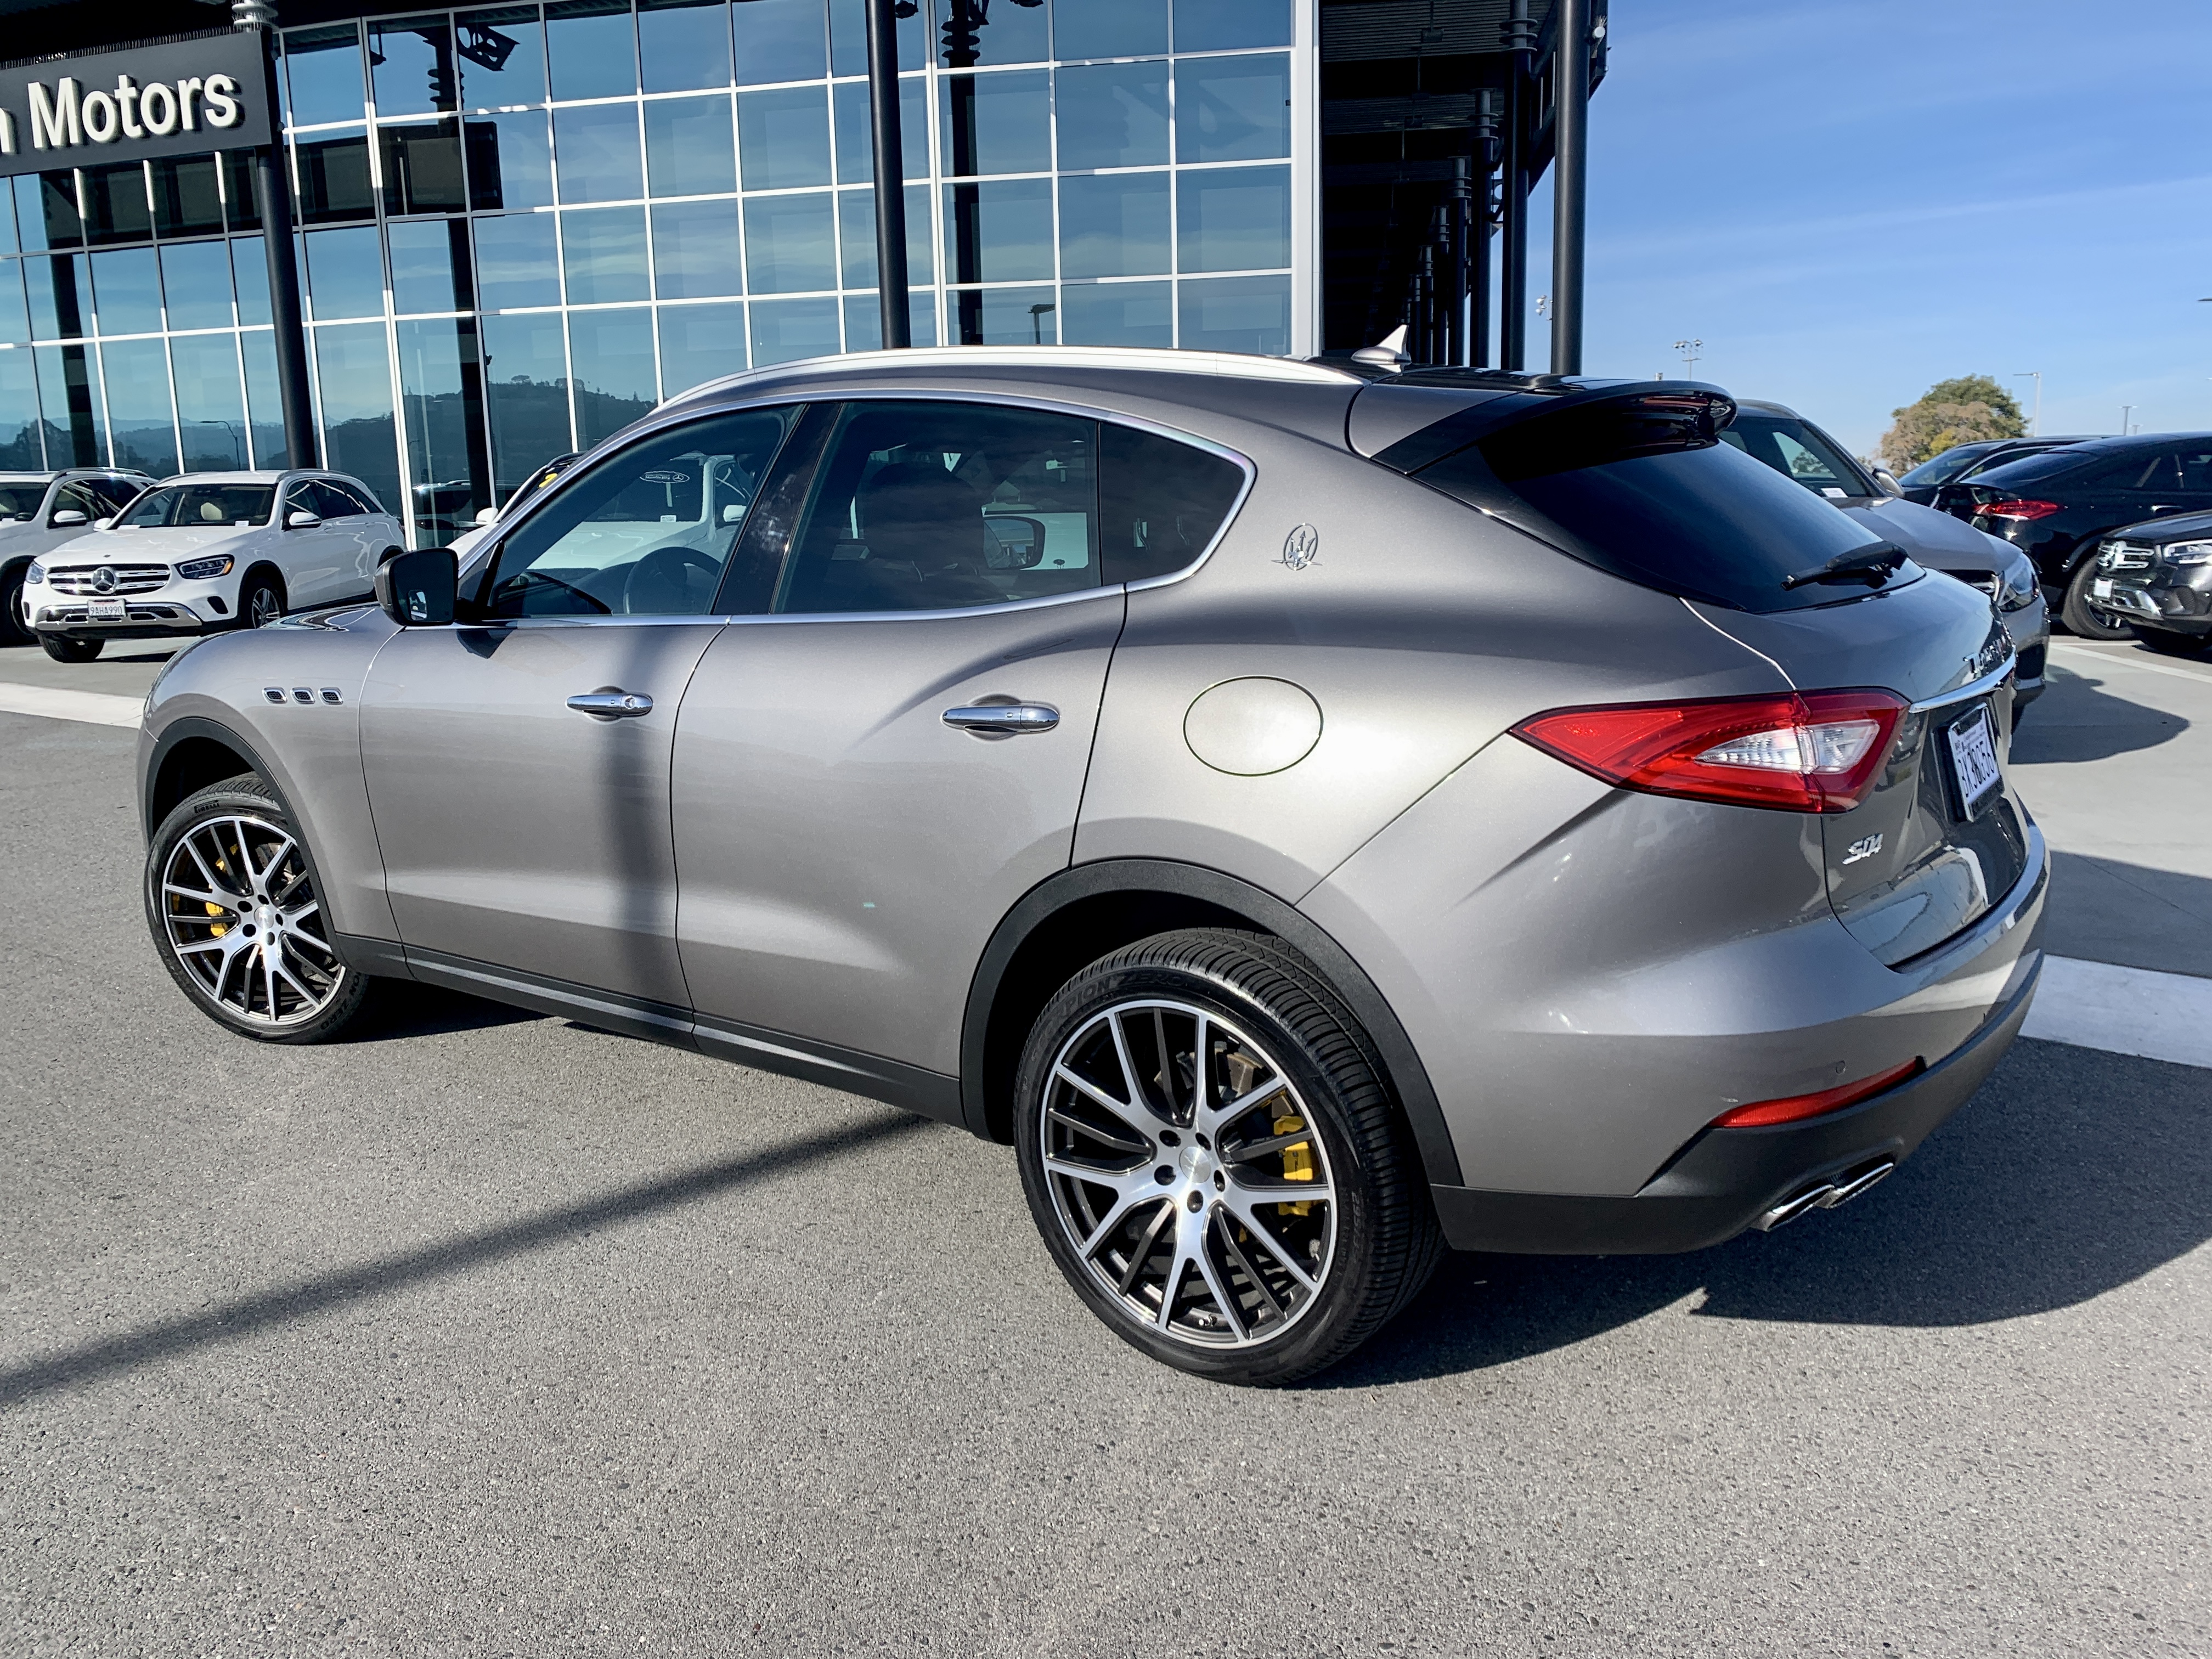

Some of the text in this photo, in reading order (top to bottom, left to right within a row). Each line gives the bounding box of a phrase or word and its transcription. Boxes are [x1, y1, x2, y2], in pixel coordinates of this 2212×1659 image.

[27, 74, 242, 149] Motors
[90, 606, 122, 615] 9AHA990
[194, 799, 219, 814] PIRELLI
